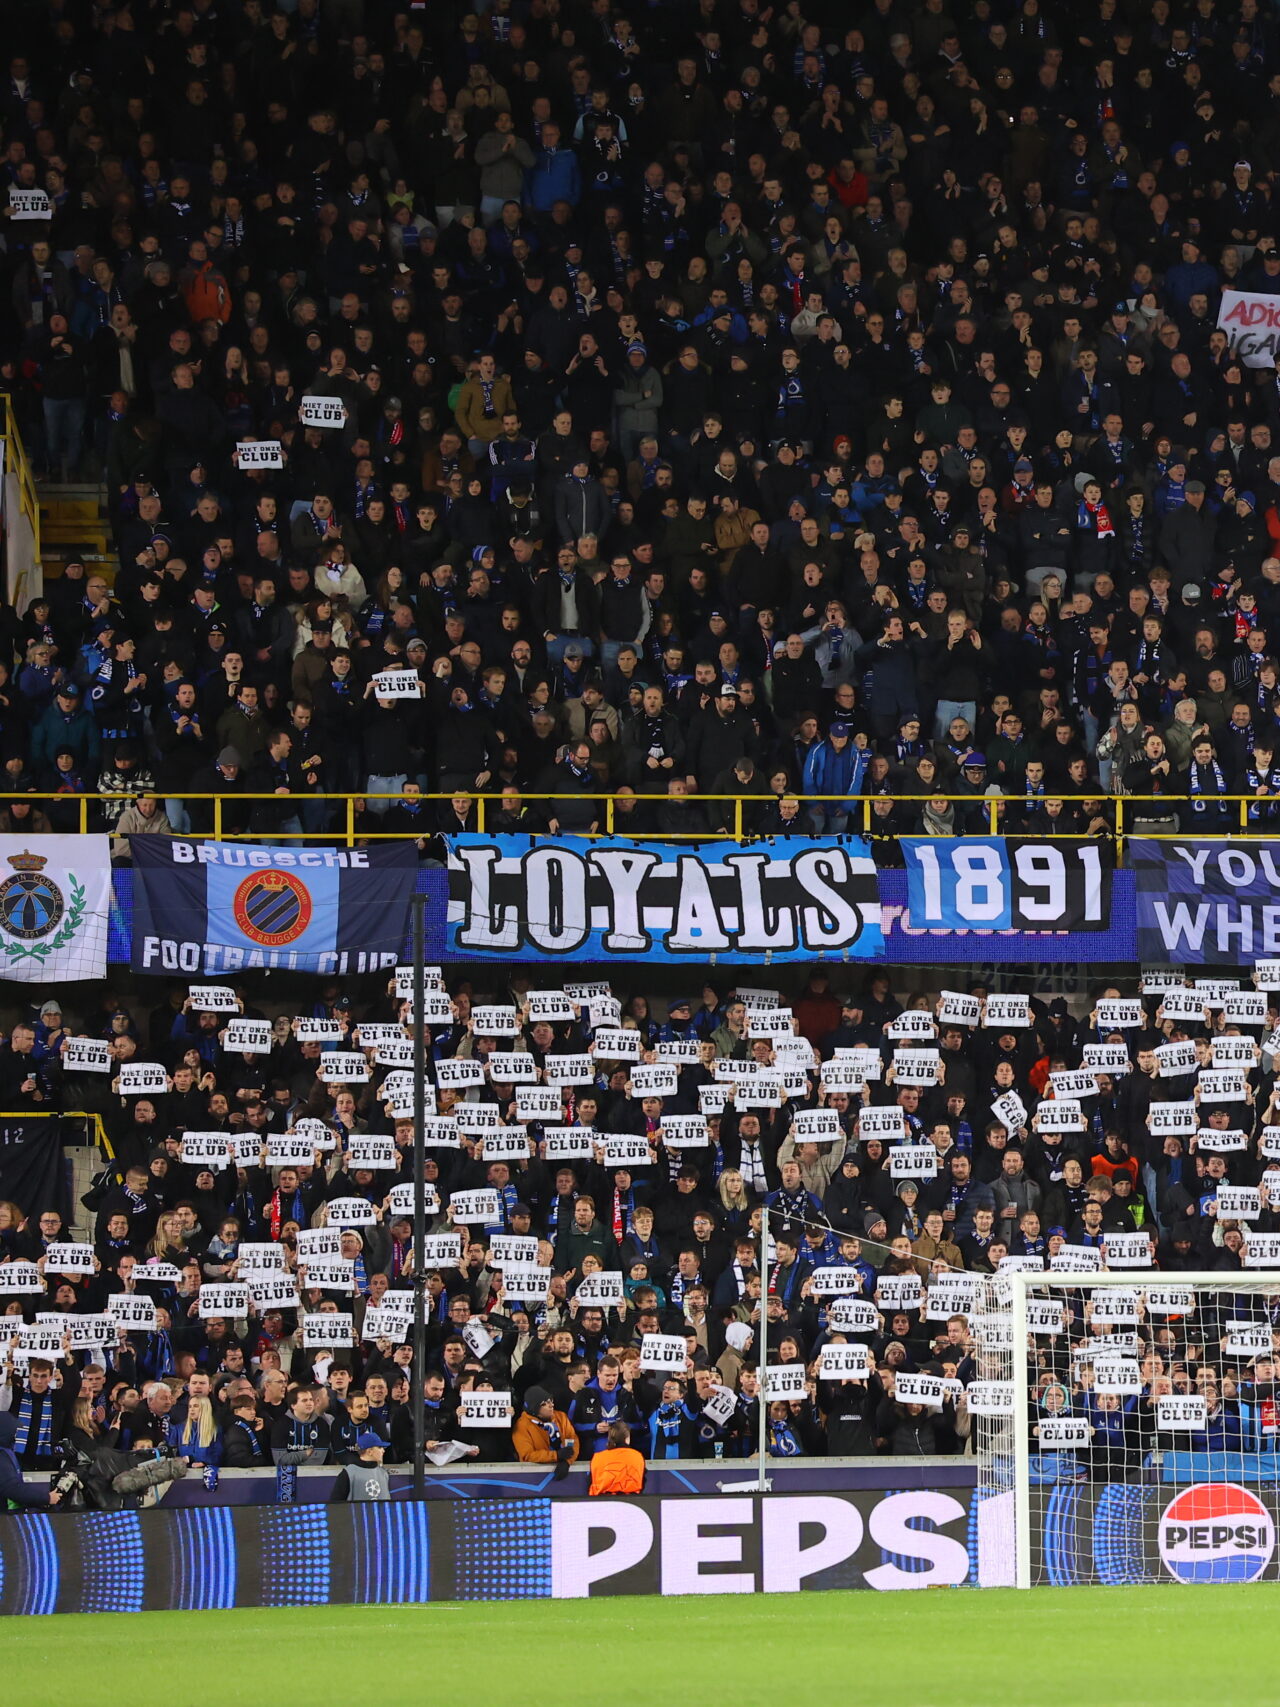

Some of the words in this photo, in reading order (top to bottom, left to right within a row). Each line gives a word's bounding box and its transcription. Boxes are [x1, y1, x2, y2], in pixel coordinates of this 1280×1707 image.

[14, 202, 48, 211] CLUB
[305, 410, 341, 420] CLUB
[242, 453, 278, 461] CLUB
[379, 682, 416, 692] CLUB
[172, 841, 370, 868] BRUGSCHE
[915, 845, 1101, 921] 1891
[458, 846, 862, 953] LOYALS
[237, 913, 255, 936] CLUB
[257, 931, 296, 944] BRUGGE
[1101, 1012, 1138, 1021] CLUB
[1088, 1056, 1124, 1066] CLUB
[325, 1065, 364, 1075] CLUB
[897, 1067, 934, 1078] CLUB
[521, 1101, 558, 1111] CLUB
[1153, 1116, 1193, 1126] CLUB
[665, 1129, 704, 1138] CLUB
[549, 1139, 589, 1150] CLUB
[186, 1146, 226, 1155] CLUB
[269, 1148, 310, 1157] CLUB
[895, 1159, 933, 1169] CLUB
[203, 1298, 244, 1308] CLUB
[899, 1384, 940, 1395] CLUB
[465, 1407, 506, 1417] CLUB
[1162, 1410, 1202, 1420] CLUB
[1044, 1429, 1084, 1440] CLUB
[1166, 1526, 1267, 1549] PEPSI
[552, 1490, 1015, 1598] PEPSI
